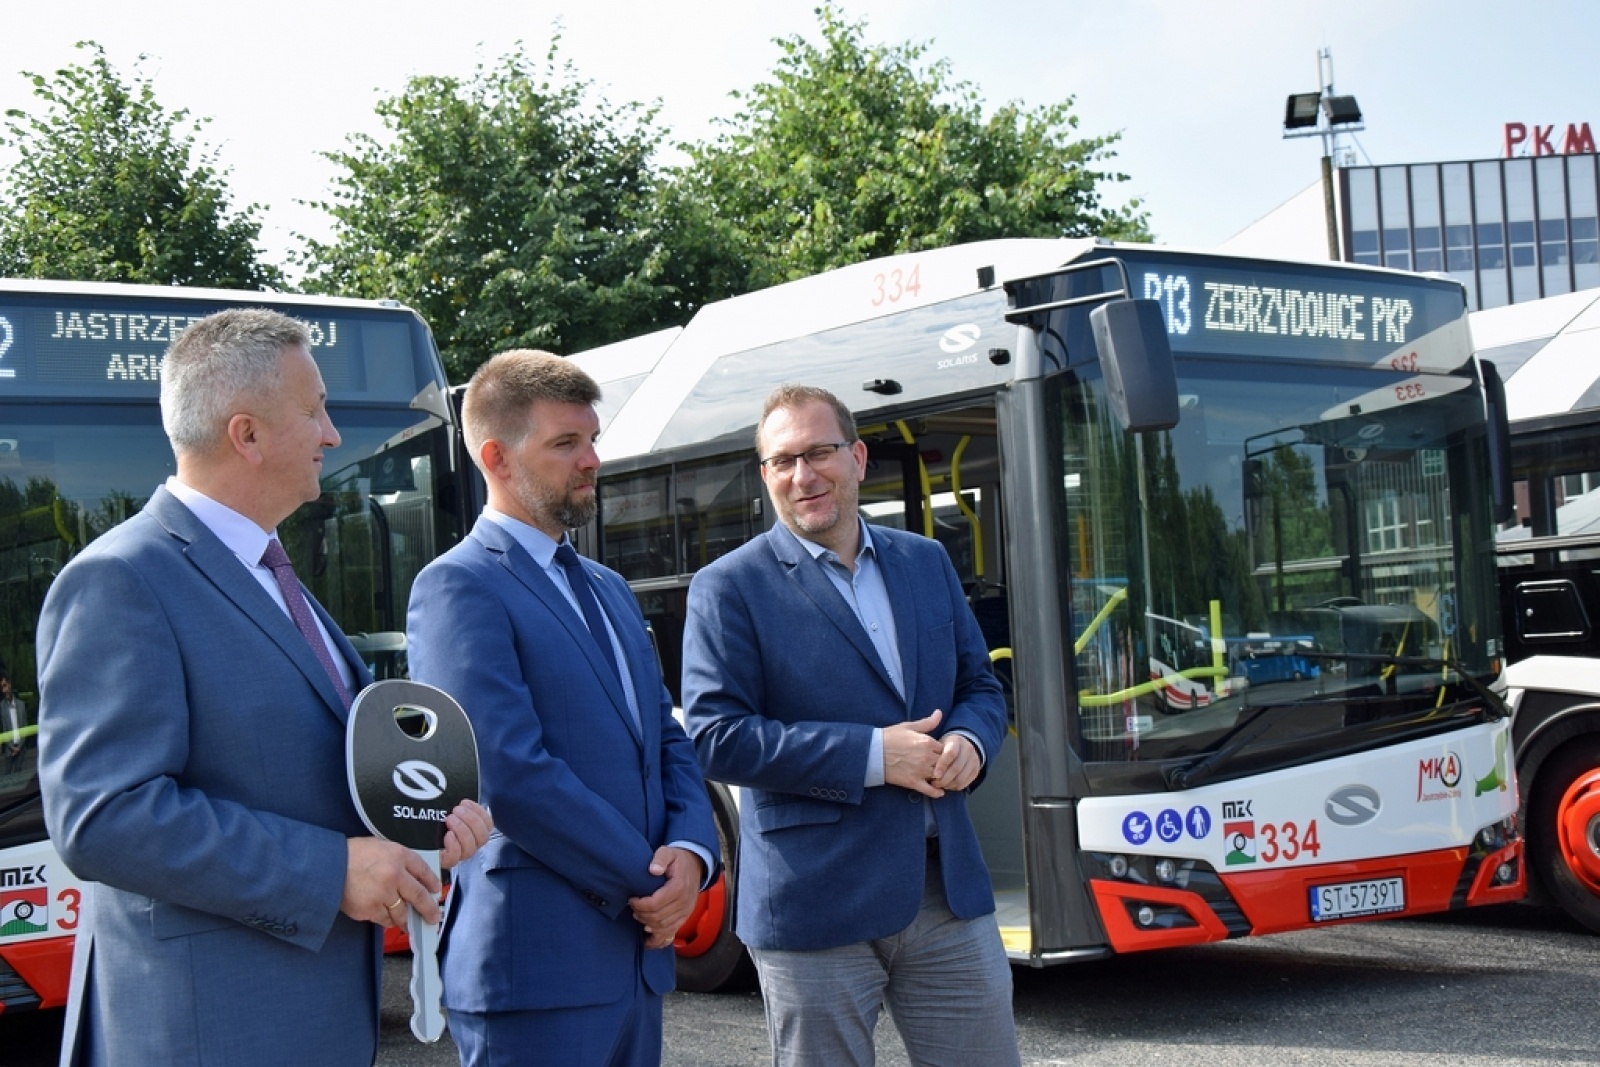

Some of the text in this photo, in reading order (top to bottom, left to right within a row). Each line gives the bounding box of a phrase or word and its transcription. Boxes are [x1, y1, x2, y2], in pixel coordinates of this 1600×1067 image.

[1505, 122, 1597, 160] PKM
[871, 263, 921, 307] 334
[1204, 282, 1365, 340] ZEBRZYDOWICE
[1371, 296, 1413, 343] PKP
[106, 353, 163, 380] ARK
[937, 353, 978, 369] SOLARIS
[393, 805, 448, 822] SOLARIS
[1222, 799, 1254, 819] MZK
[1260, 819, 1321, 863] 334
[57, 888, 81, 930] 3
[1322, 881, 1398, 912] ST 5739T
